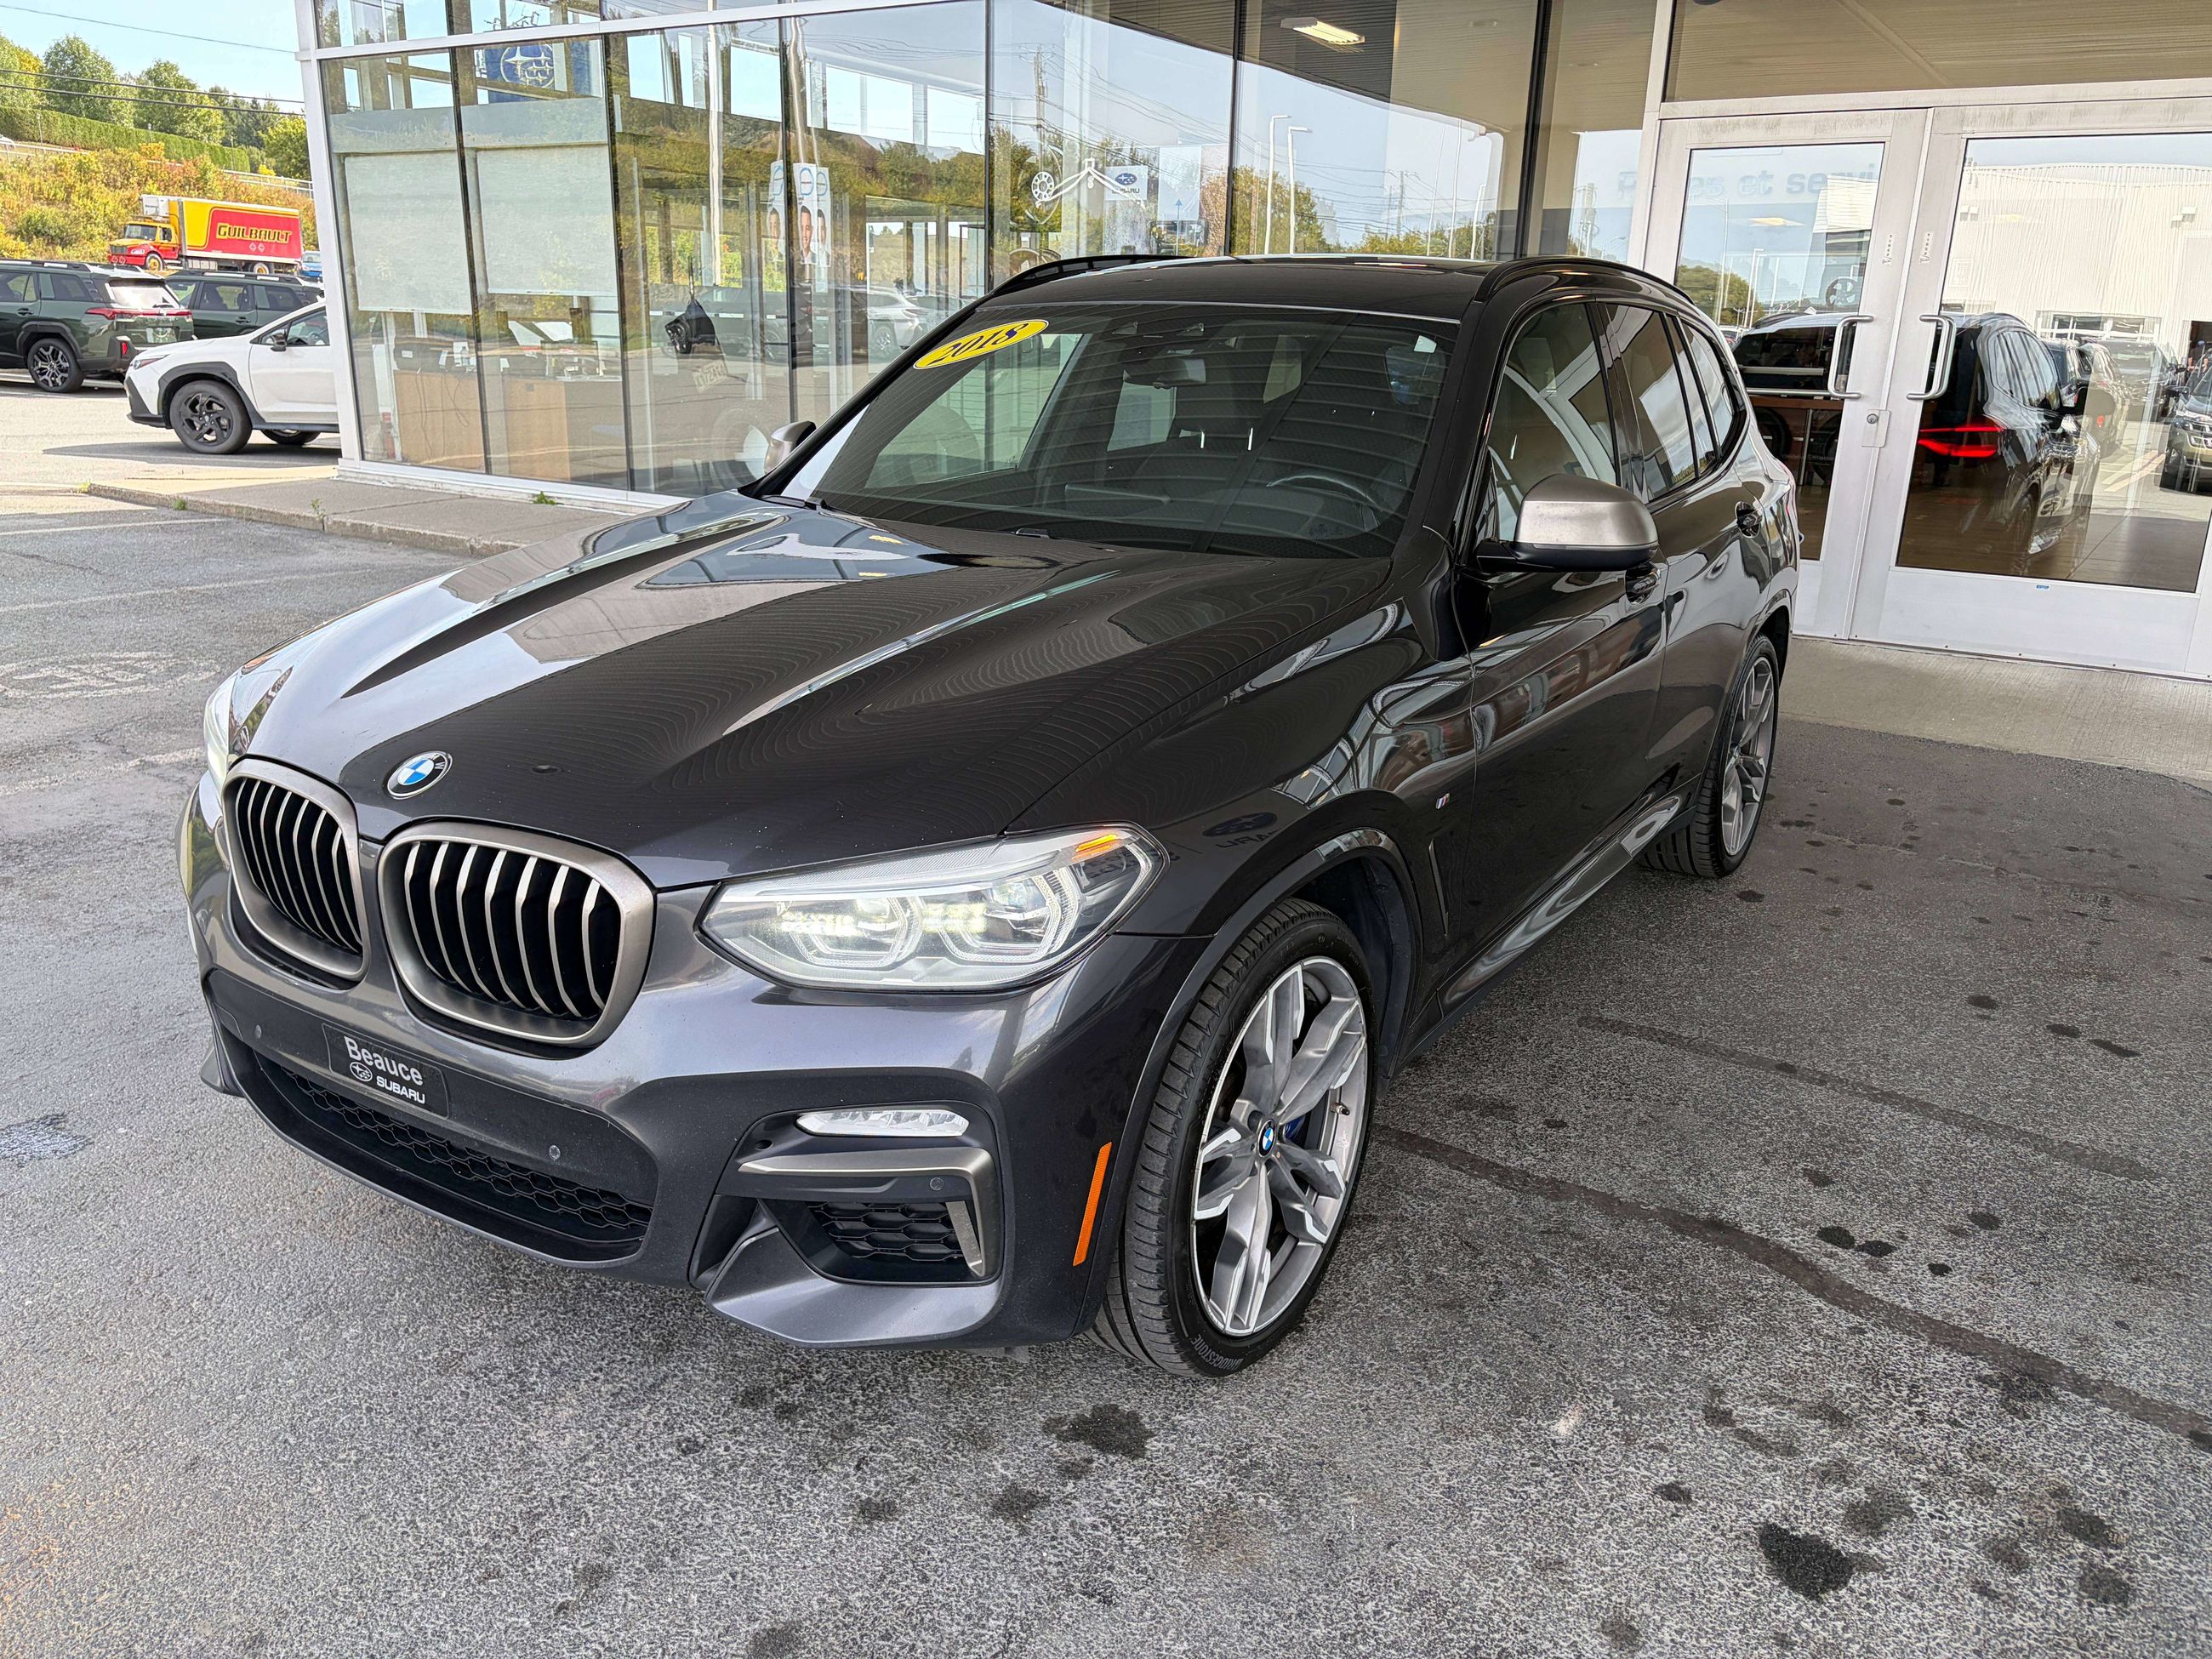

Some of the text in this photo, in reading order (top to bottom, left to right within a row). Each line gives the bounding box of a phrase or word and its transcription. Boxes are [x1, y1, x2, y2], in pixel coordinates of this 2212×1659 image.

[216, 223, 292, 244] GUILBAULT
[926, 322, 1029, 366] 2018
[344, 1035, 424, 1086] Beauce
[376, 1075, 425, 1104] SUBARU
